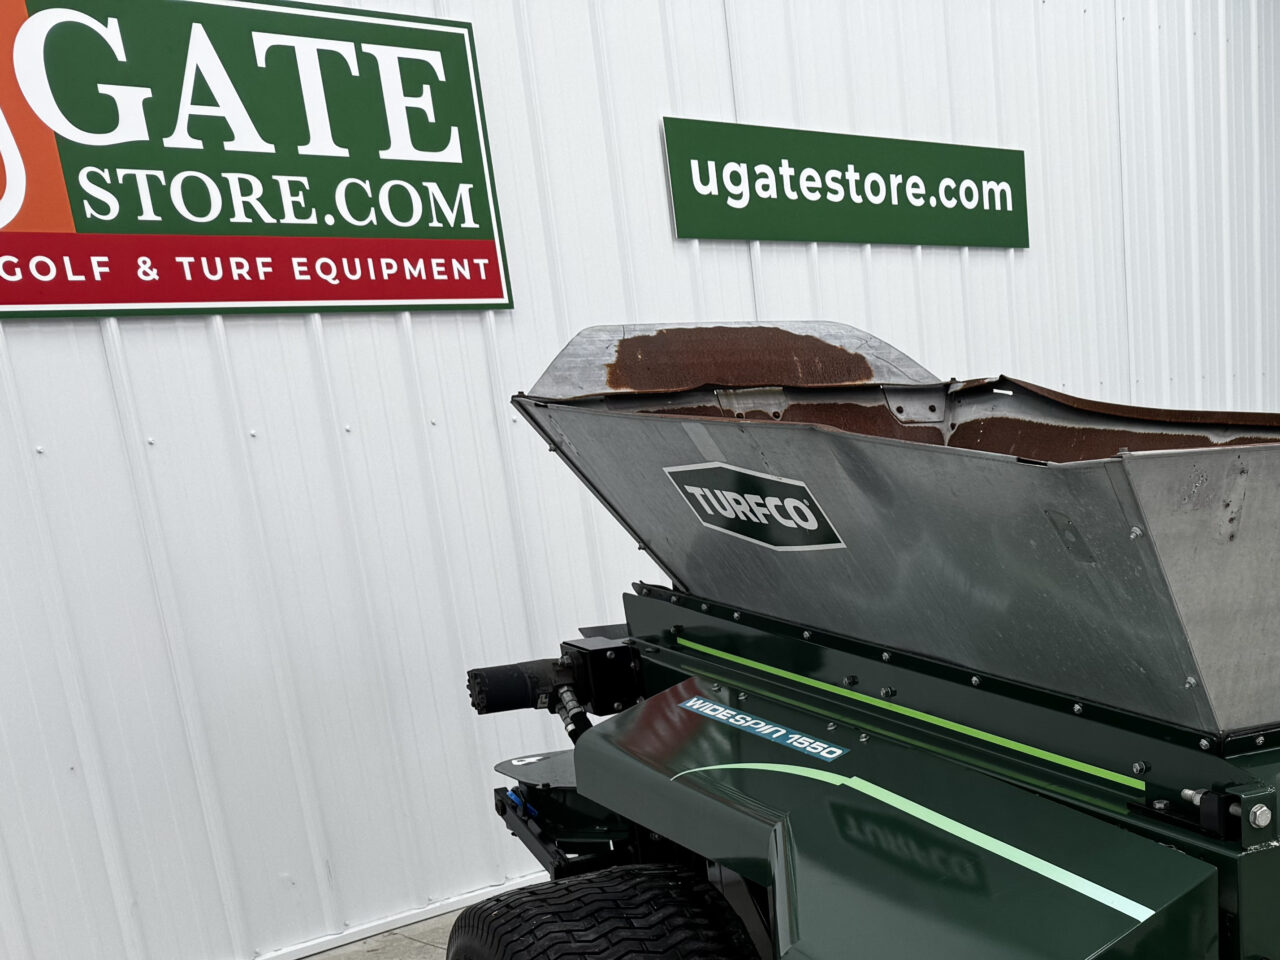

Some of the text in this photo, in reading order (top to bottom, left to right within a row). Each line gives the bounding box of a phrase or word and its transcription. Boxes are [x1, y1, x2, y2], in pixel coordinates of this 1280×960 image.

[78, 166, 480, 229] STORE.COM
[690, 158, 1014, 212] ugatestore.com
[0, 255, 490, 285] GOLF & TURF EQUIPMENT
[684, 485, 818, 531] TURFCO
[787, 733, 843, 759] 1550
